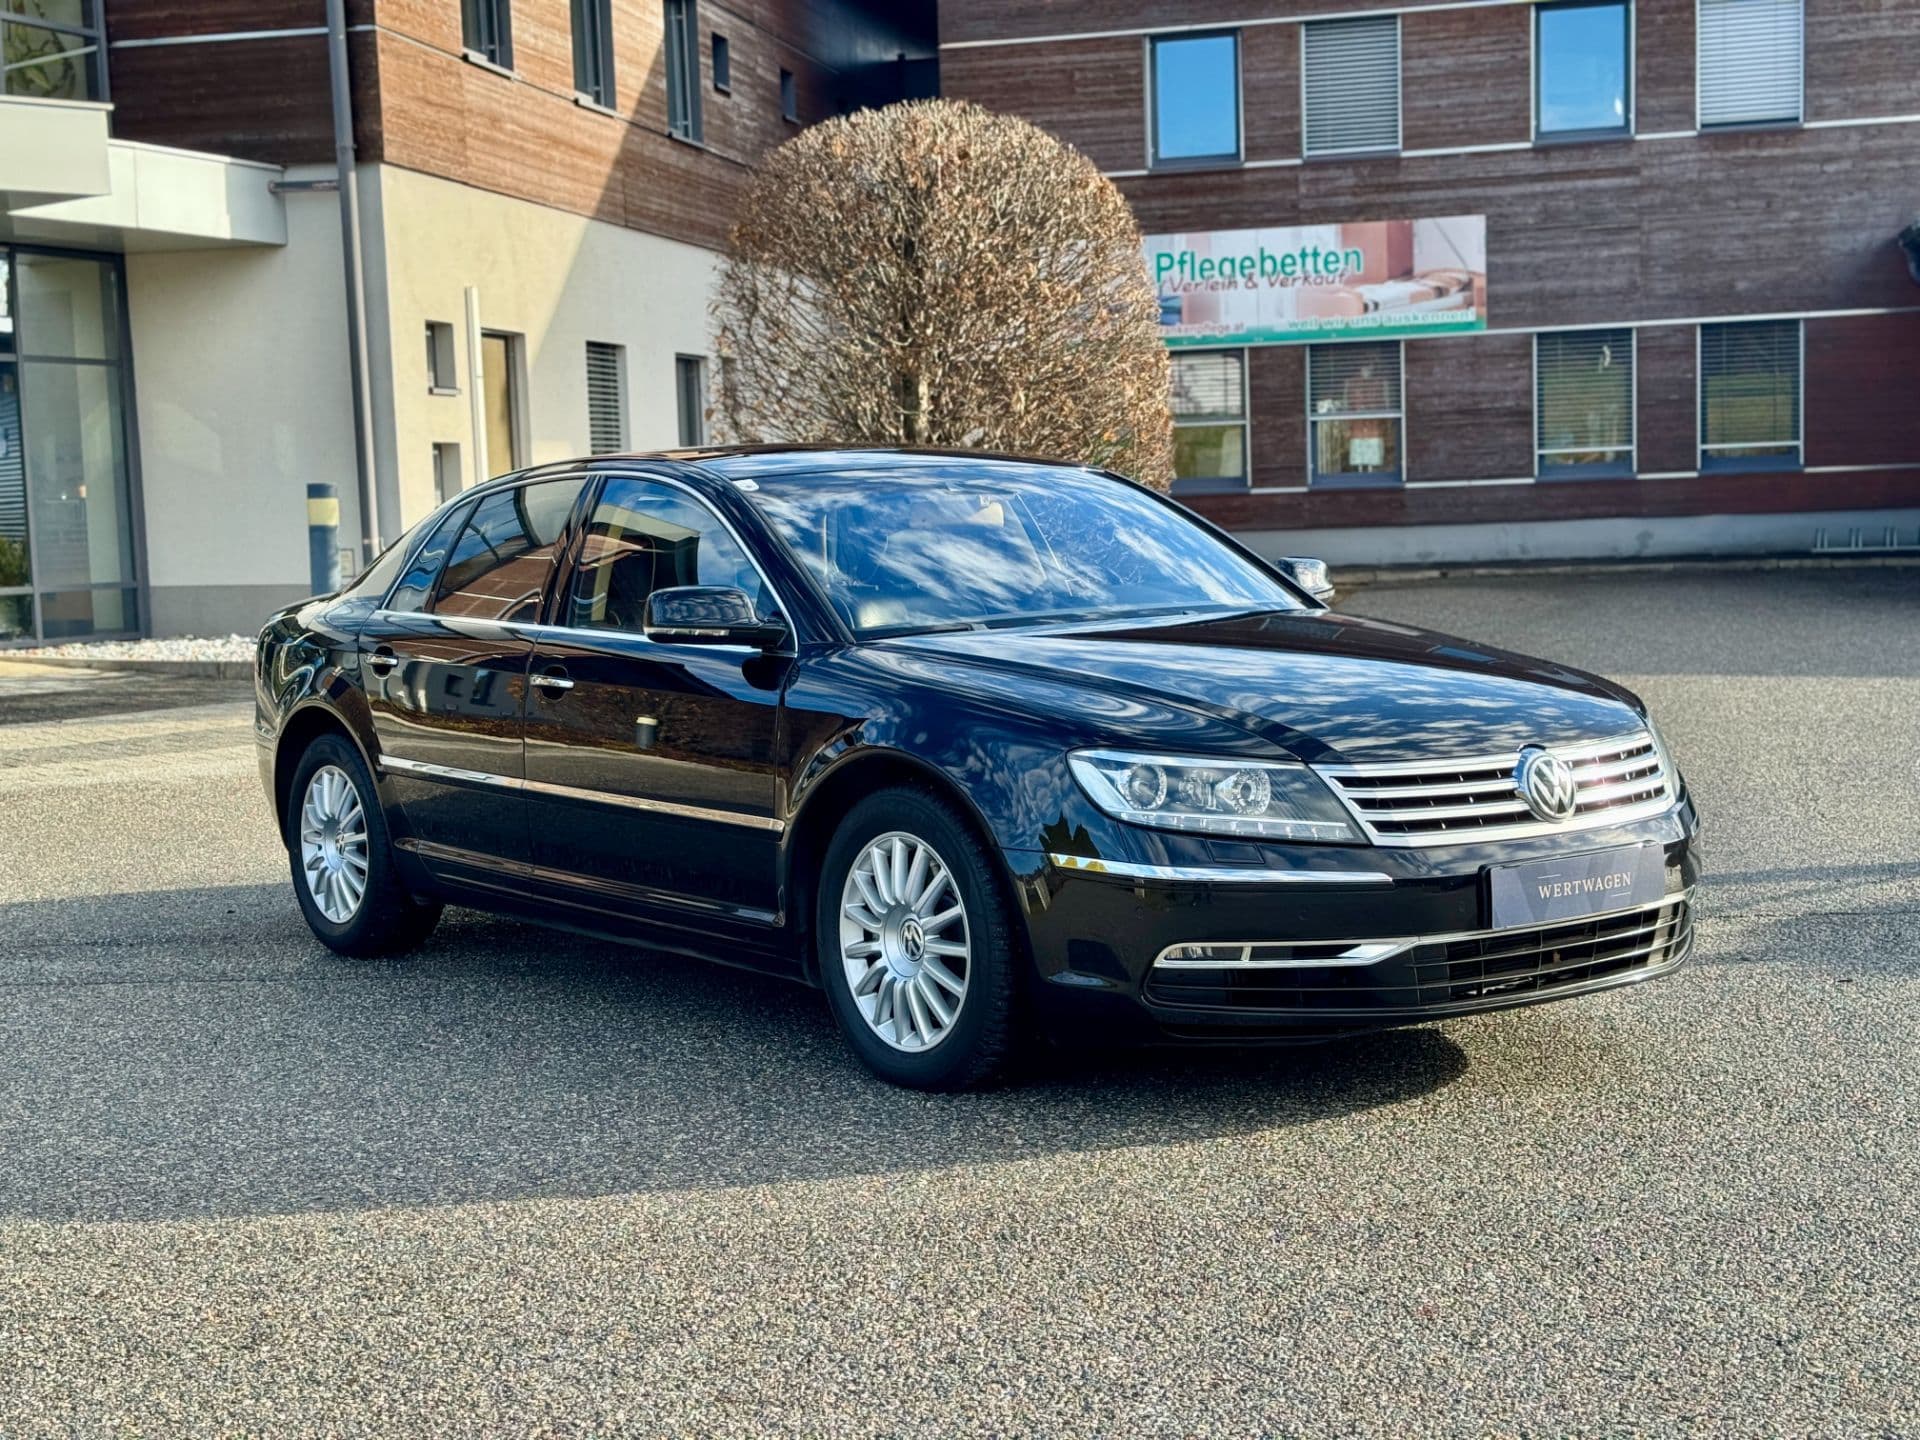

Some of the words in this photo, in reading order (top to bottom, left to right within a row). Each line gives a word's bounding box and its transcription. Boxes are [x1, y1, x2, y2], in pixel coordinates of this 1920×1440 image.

[1155, 246, 1362, 283] Pflegebetten
[1168, 275, 1239, 293] Verleih
[1244, 272, 1259, 290] &
[1266, 269, 1347, 289] Verkauf
[1538, 871, 1632, 899] WERTWAGEN
